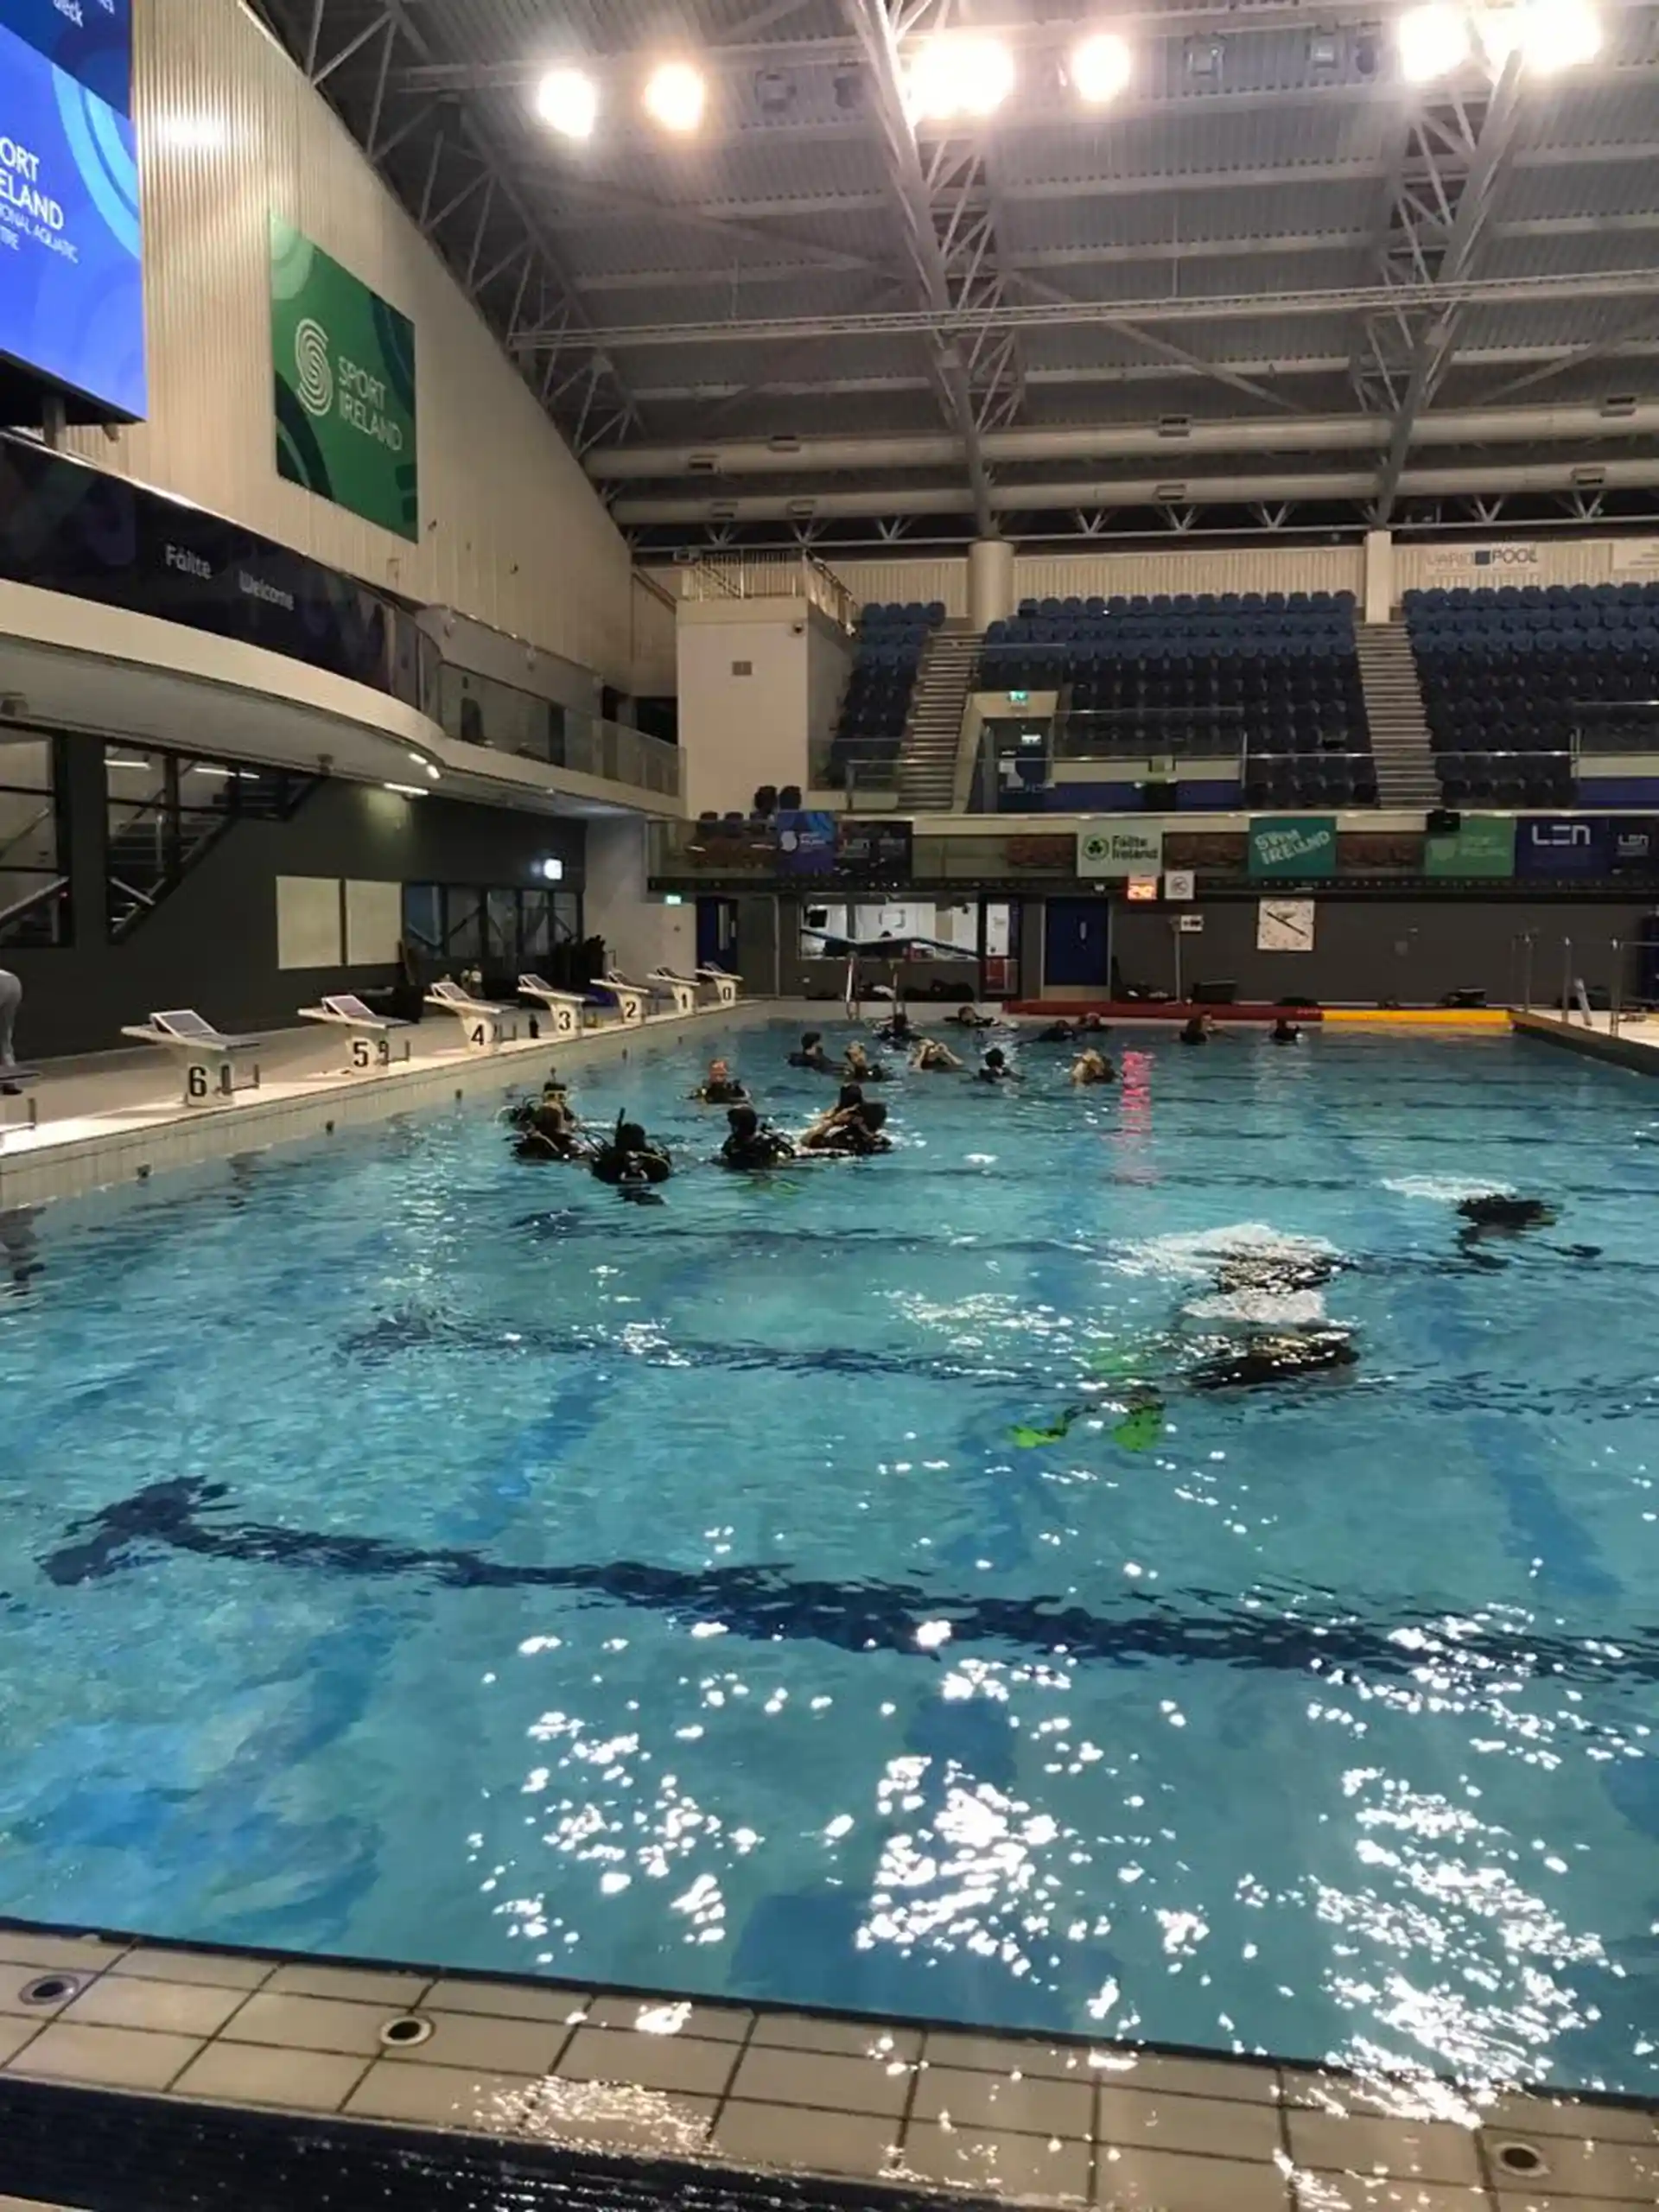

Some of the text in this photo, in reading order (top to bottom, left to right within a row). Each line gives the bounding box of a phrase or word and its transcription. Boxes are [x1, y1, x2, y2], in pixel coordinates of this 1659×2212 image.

[339, 356, 385, 410] SPORT
[340, 390, 403, 451] IRELAND
[1492, 548, 1538, 563] POOL
[238, 569, 295, 611] Welcome
[1532, 825, 1591, 845] LEN
[1112, 847, 1158, 860] Ireland
[1262, 830, 1330, 864] IRELAND
[626, 1001, 636, 1019] 2
[681, 993, 688, 1009] 1
[558, 1011, 571, 1031] 3
[471, 1024, 485, 1046] 4
[353, 1041, 368, 1067] 5
[189, 1065, 207, 1097] 6
